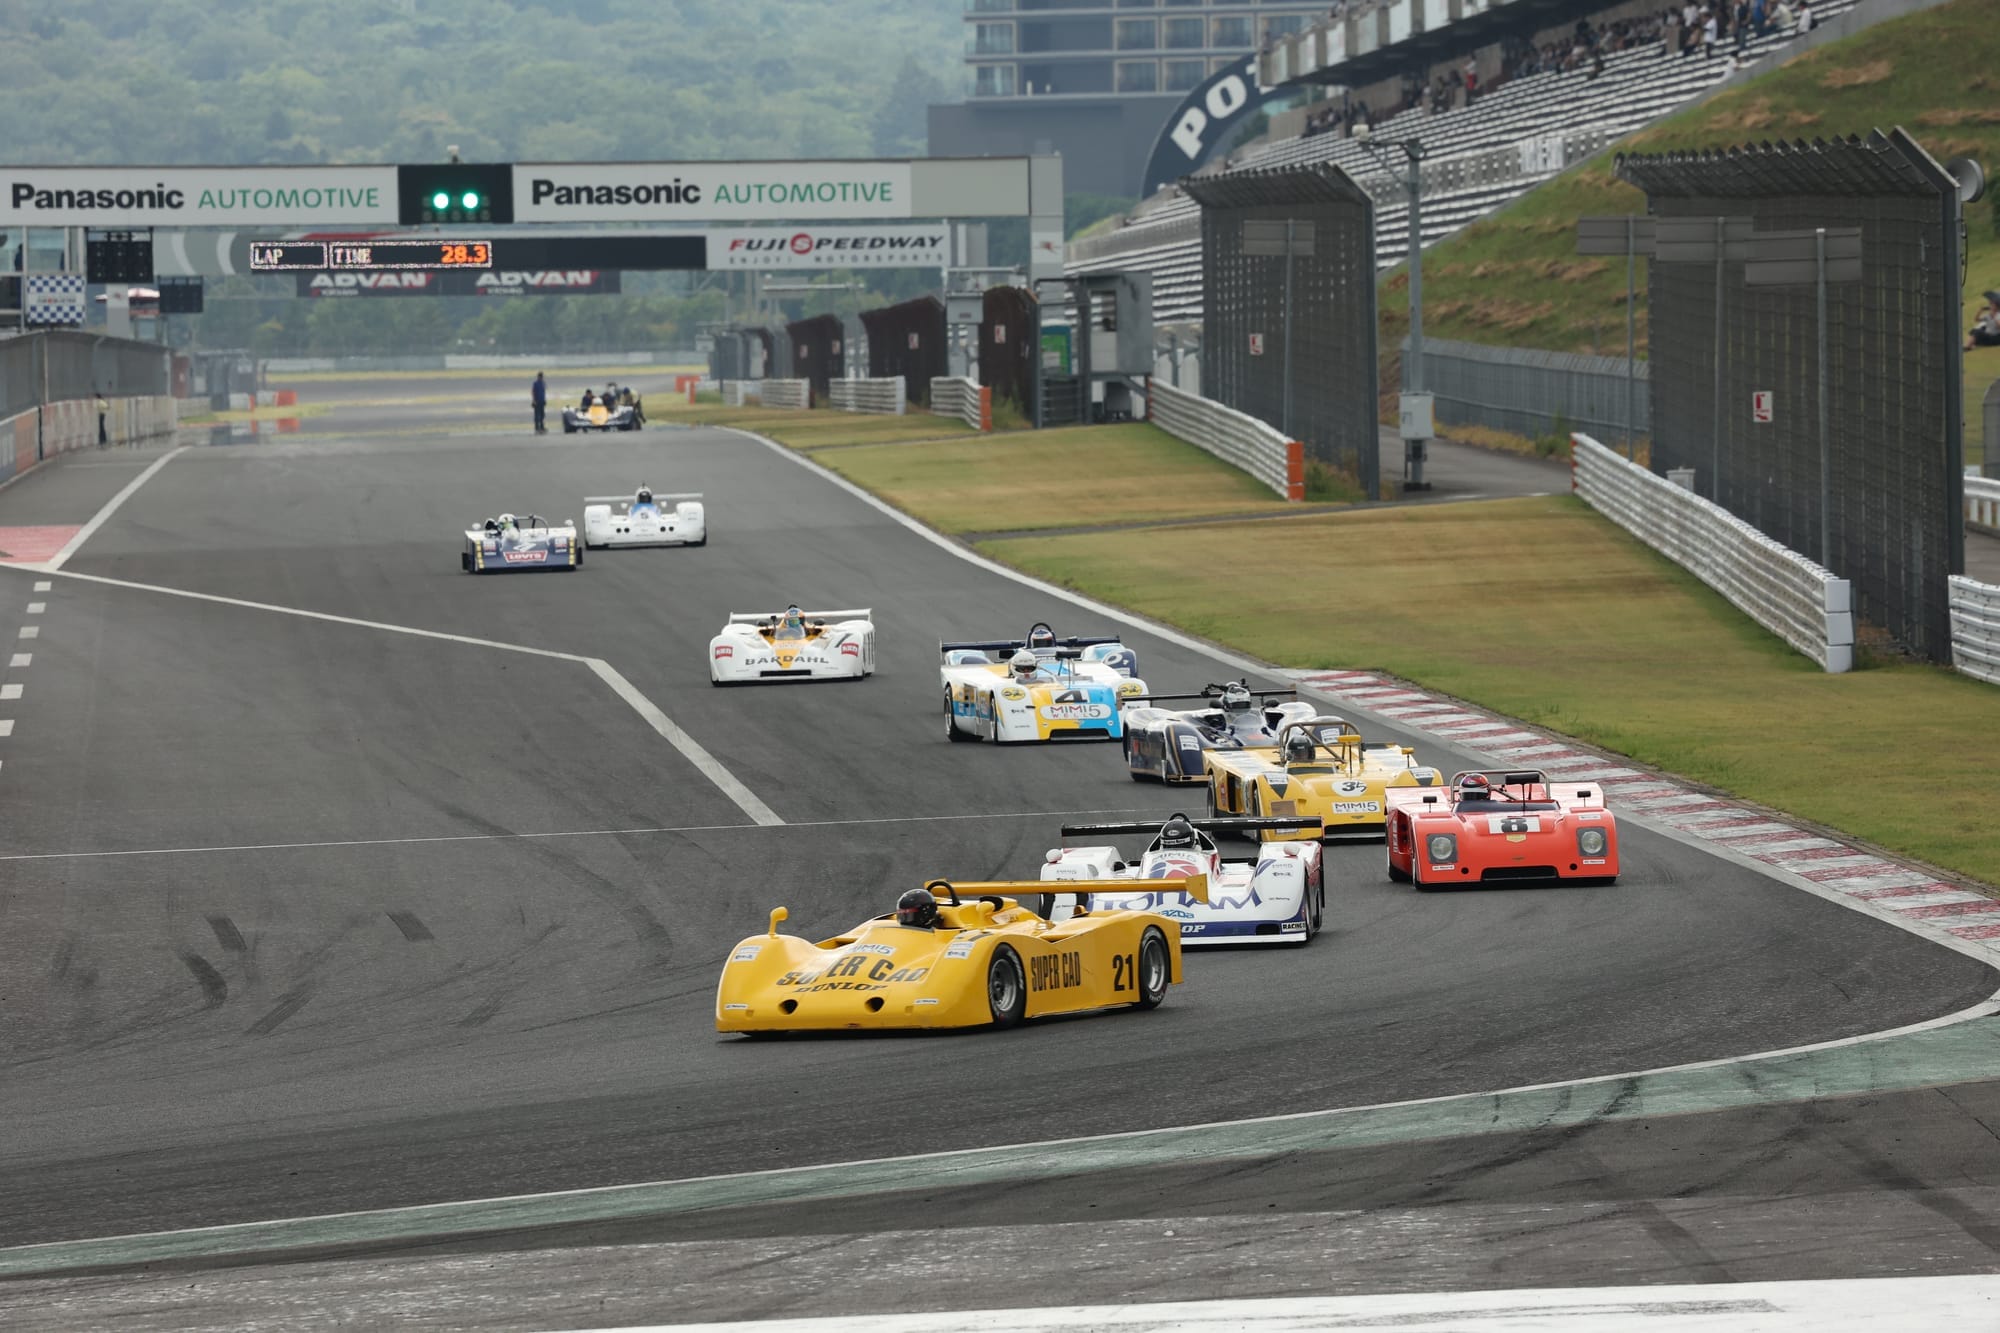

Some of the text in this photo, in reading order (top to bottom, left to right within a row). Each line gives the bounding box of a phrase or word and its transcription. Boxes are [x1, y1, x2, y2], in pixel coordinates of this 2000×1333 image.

[12, 183, 380, 209] Panasonic AUTOMOTIVE
[532, 179, 893, 205] Panasonic AUTOMOTIVE
[729, 233, 944, 255] FUJI SPEEDWAY
[254, 249, 283, 264] LAP
[334, 245, 488, 263] TIME 28.3
[310, 272, 432, 288] ADVAN
[475, 270, 599, 287] ADVAN
[745, 655, 830, 666] BARDAHL
[1054, 690, 1087, 703] 4
[1050, 704, 1101, 718] MIMI5
[1335, 802, 1377, 812] MIMI5
[1031, 952, 1059, 992] SUPER
[1063, 952, 1081, 987] CAD
[1112, 954, 1134, 991] 21
[792, 982, 887, 993] DUNLOP
